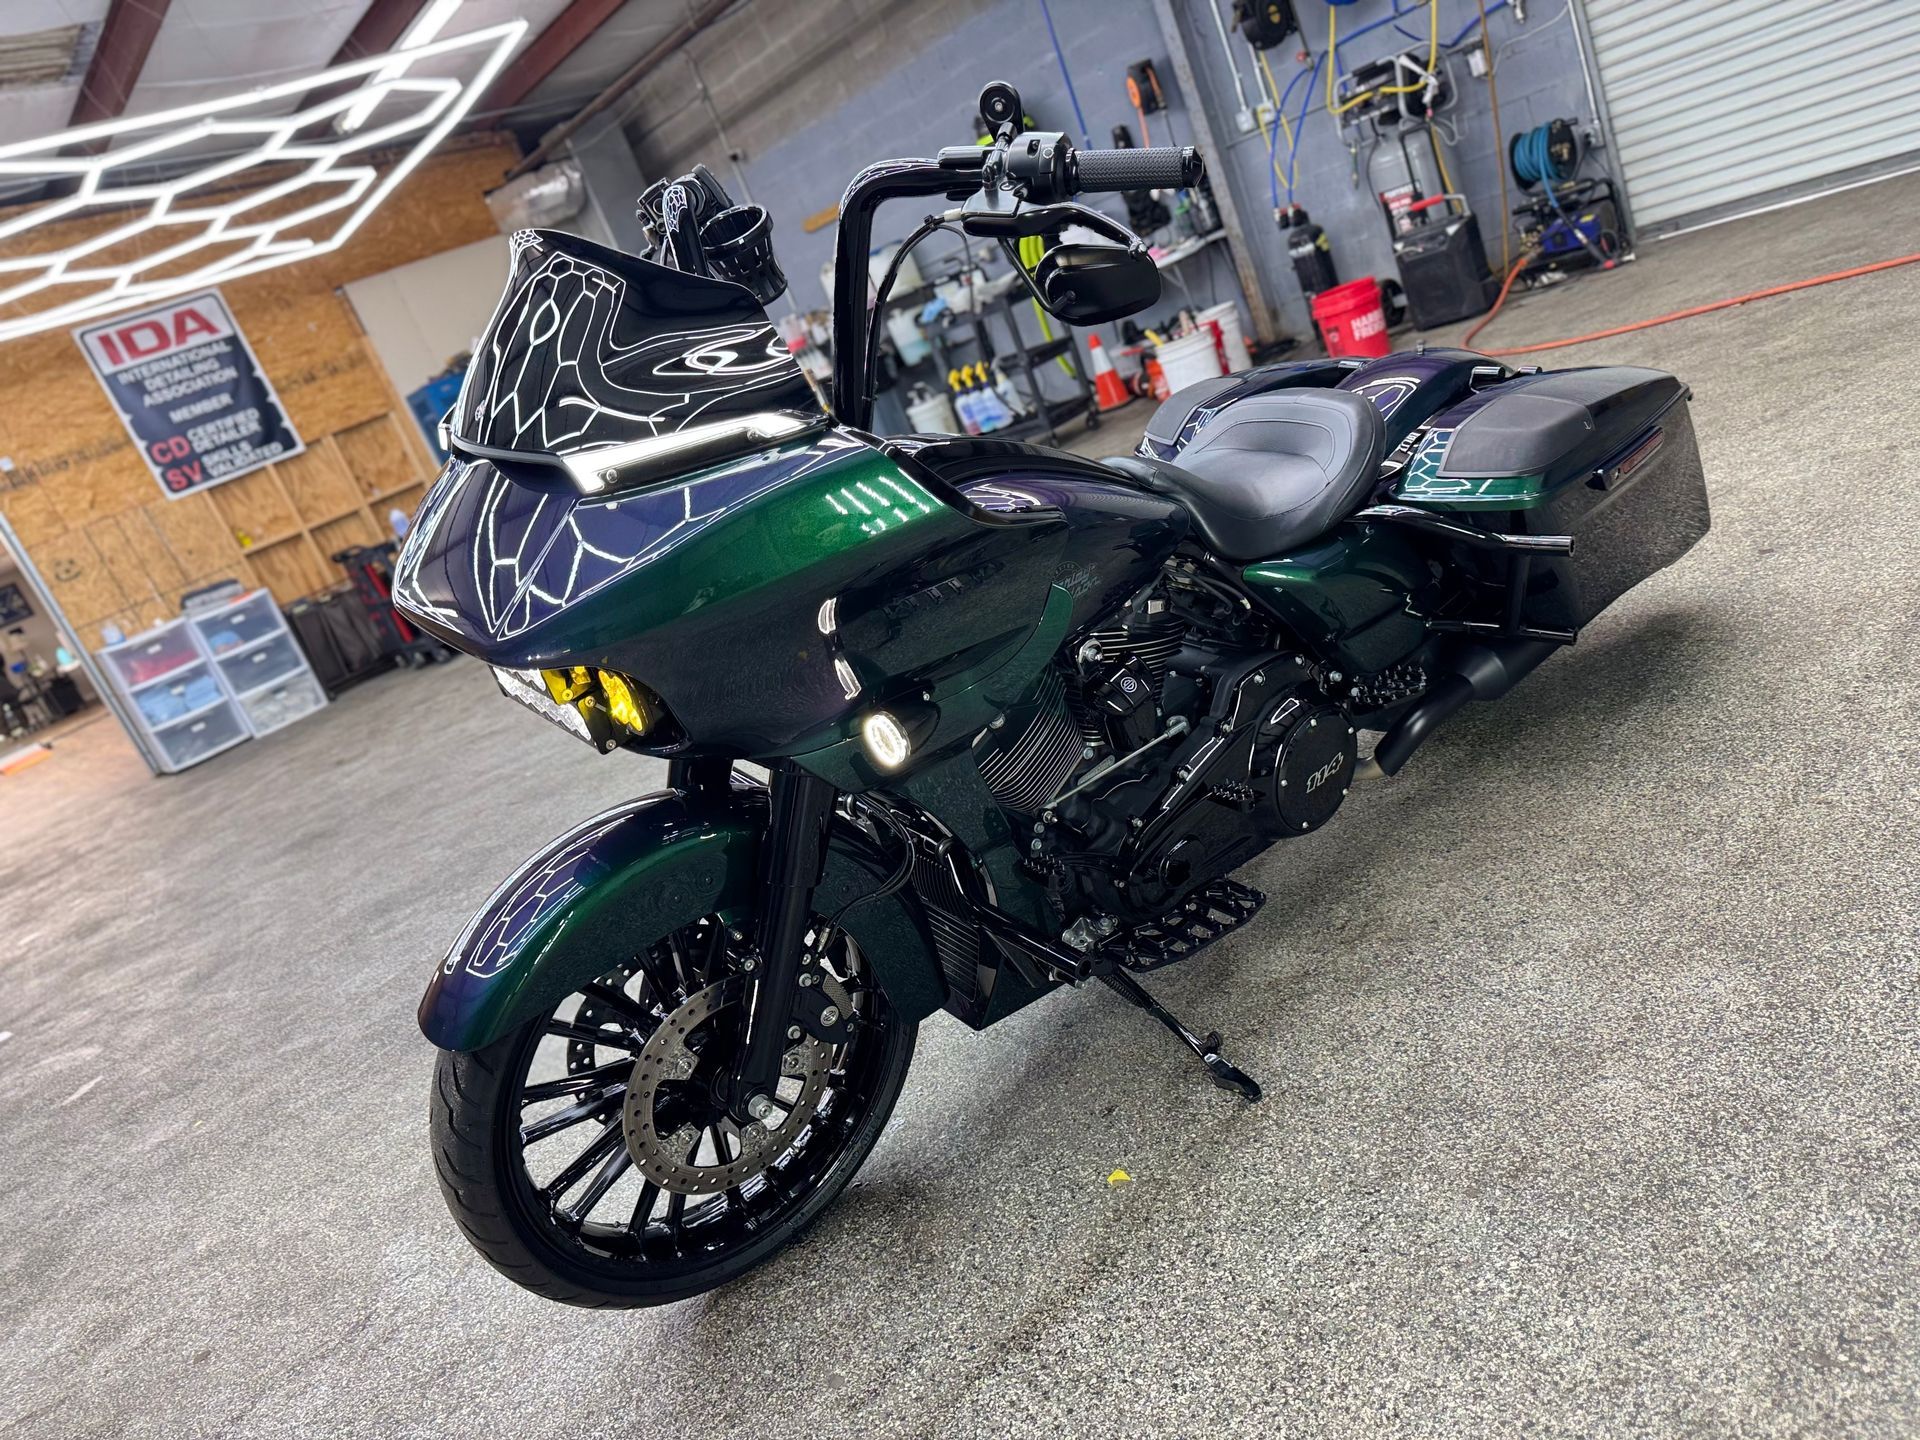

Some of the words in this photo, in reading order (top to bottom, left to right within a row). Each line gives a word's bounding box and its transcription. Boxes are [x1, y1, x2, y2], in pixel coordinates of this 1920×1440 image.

[98, 308, 222, 366] IDA
[116, 340, 233, 386] INTERNATIONAL
[143, 357, 221, 392] DETAILING
[143, 366, 239, 408] ASSOCIATION
[168, 392, 234, 425] MEMBER
[151, 435, 191, 464] CD
[186, 407, 261, 441] CERTIFIED
[190, 420, 263, 454] DETAILER
[166, 460, 203, 490] SV
[201, 440, 254, 467] SKILLS
[204, 441, 284, 479] VALIDATED
[1306, 751, 1344, 794] 114
